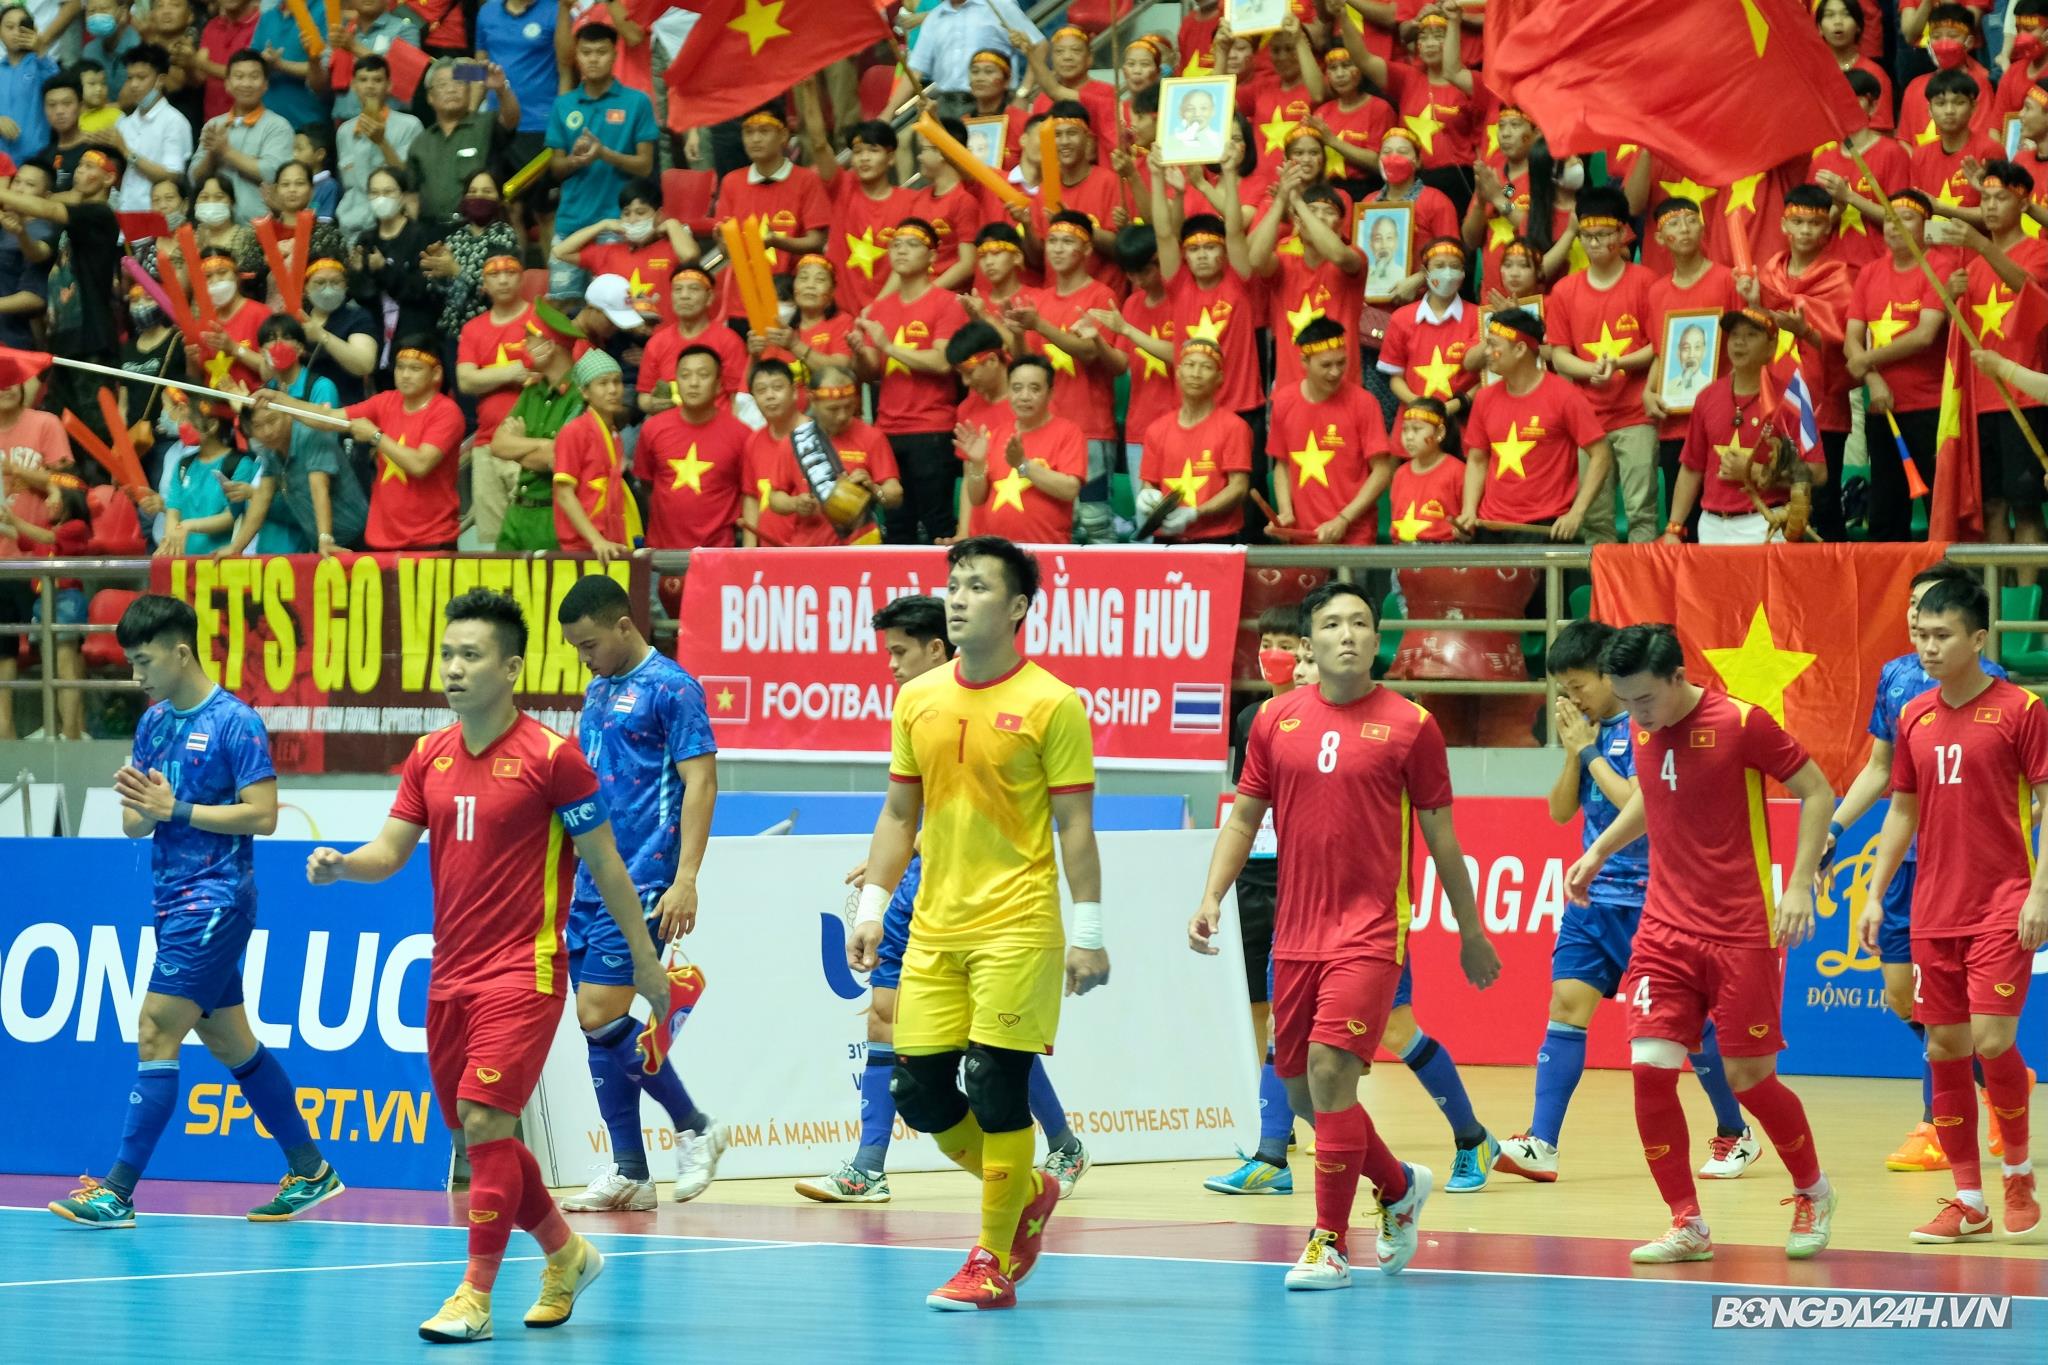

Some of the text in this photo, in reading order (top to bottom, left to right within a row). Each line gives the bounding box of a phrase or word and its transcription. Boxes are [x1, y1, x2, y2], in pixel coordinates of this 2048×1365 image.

[312, 555, 384, 694] GO
[398, 557, 631, 696] VINA
[720, 570, 878, 654] BÓNG ĐÁ
[1024, 555, 1210, 660] BẰNG HỮU
[762, 682, 894, 721] FOOTBAL
[958, 718, 968, 764] 1
[1317, 730, 1341, 774] 8
[1661, 749, 1678, 791] 4
[1934, 743, 1962, 785] 12
[453, 795, 477, 842] 11
[563, 802, 596, 827] AFC
[0, 922, 434, 1053] ONLUC
[1632, 975, 1653, 1016] 4
[1806, 981, 1862, 1012] ĐỘNG
[767, 1117, 782, 1147] Á
[784, 1119, 841, 1150] MẠNH
[1088, 1107, 1189, 1134] SOUTHEAST
[1196, 1106, 1236, 1129] ASIA
